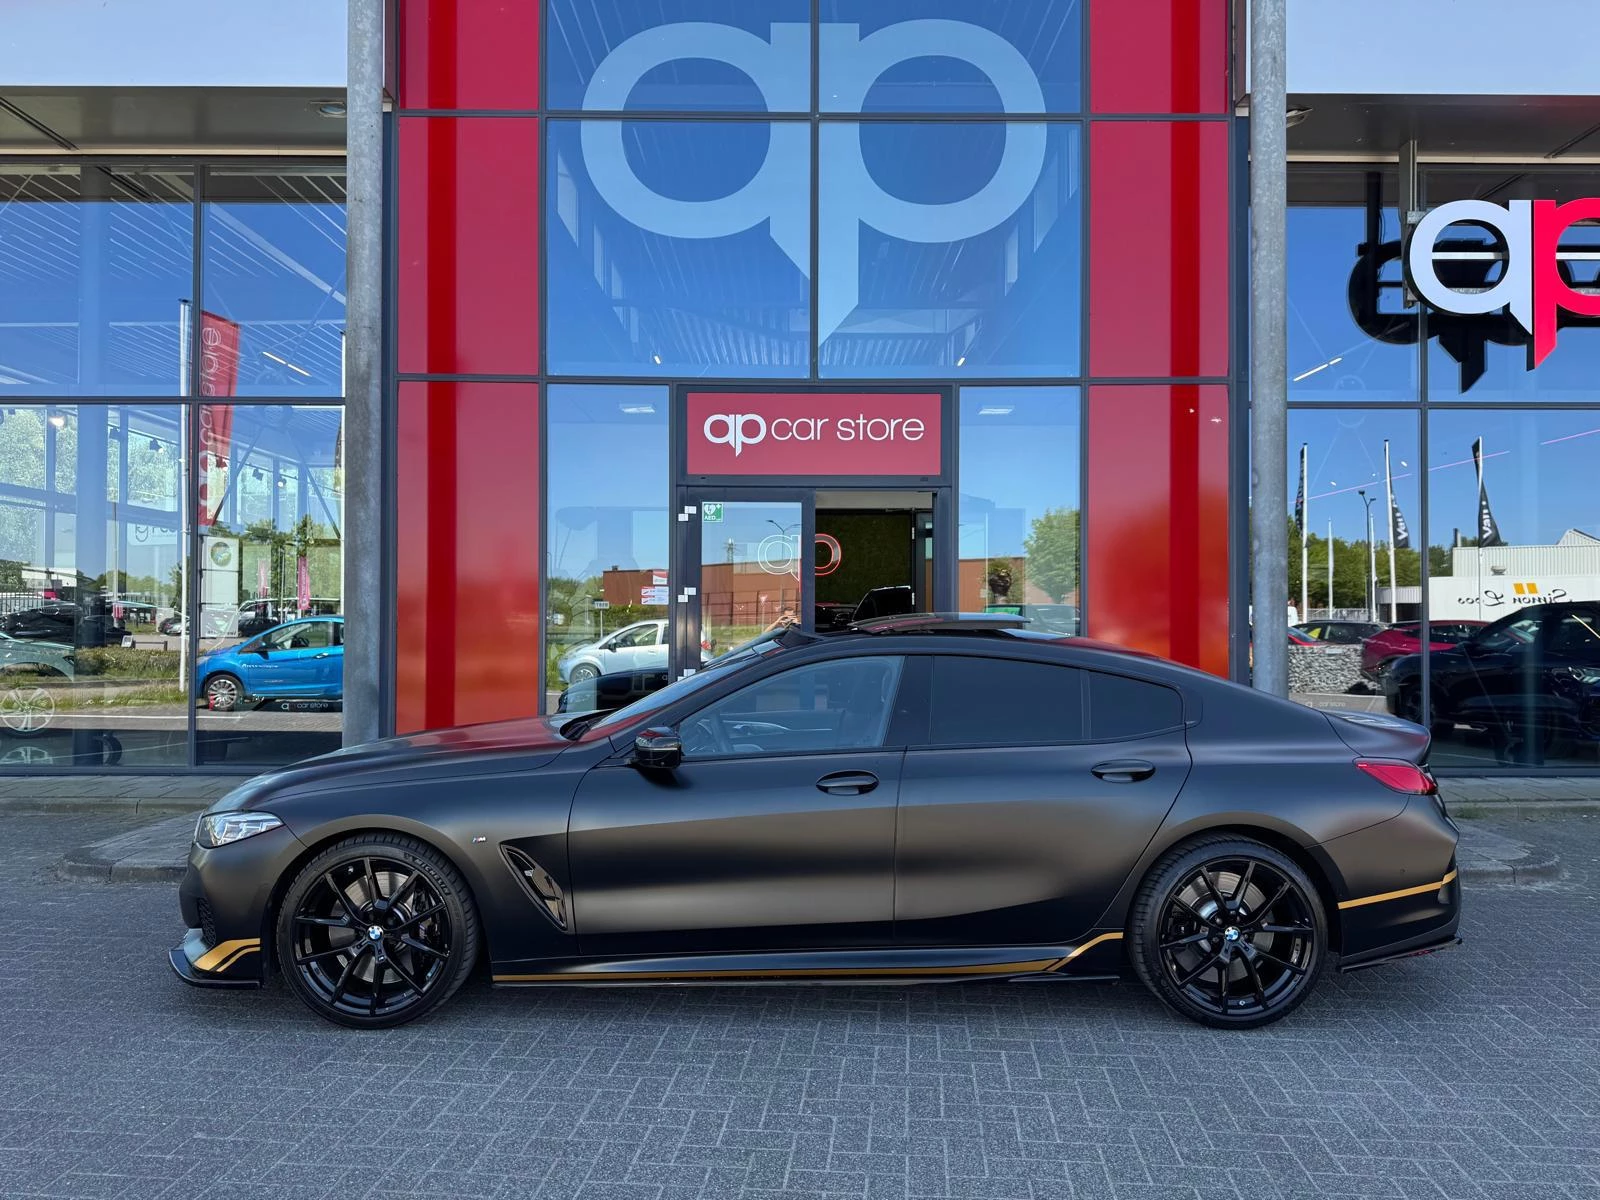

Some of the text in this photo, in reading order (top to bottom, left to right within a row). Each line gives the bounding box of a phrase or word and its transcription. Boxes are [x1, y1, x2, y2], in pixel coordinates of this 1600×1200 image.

[581, 18, 1047, 348] ap
[704, 414, 925, 457] ap car store
